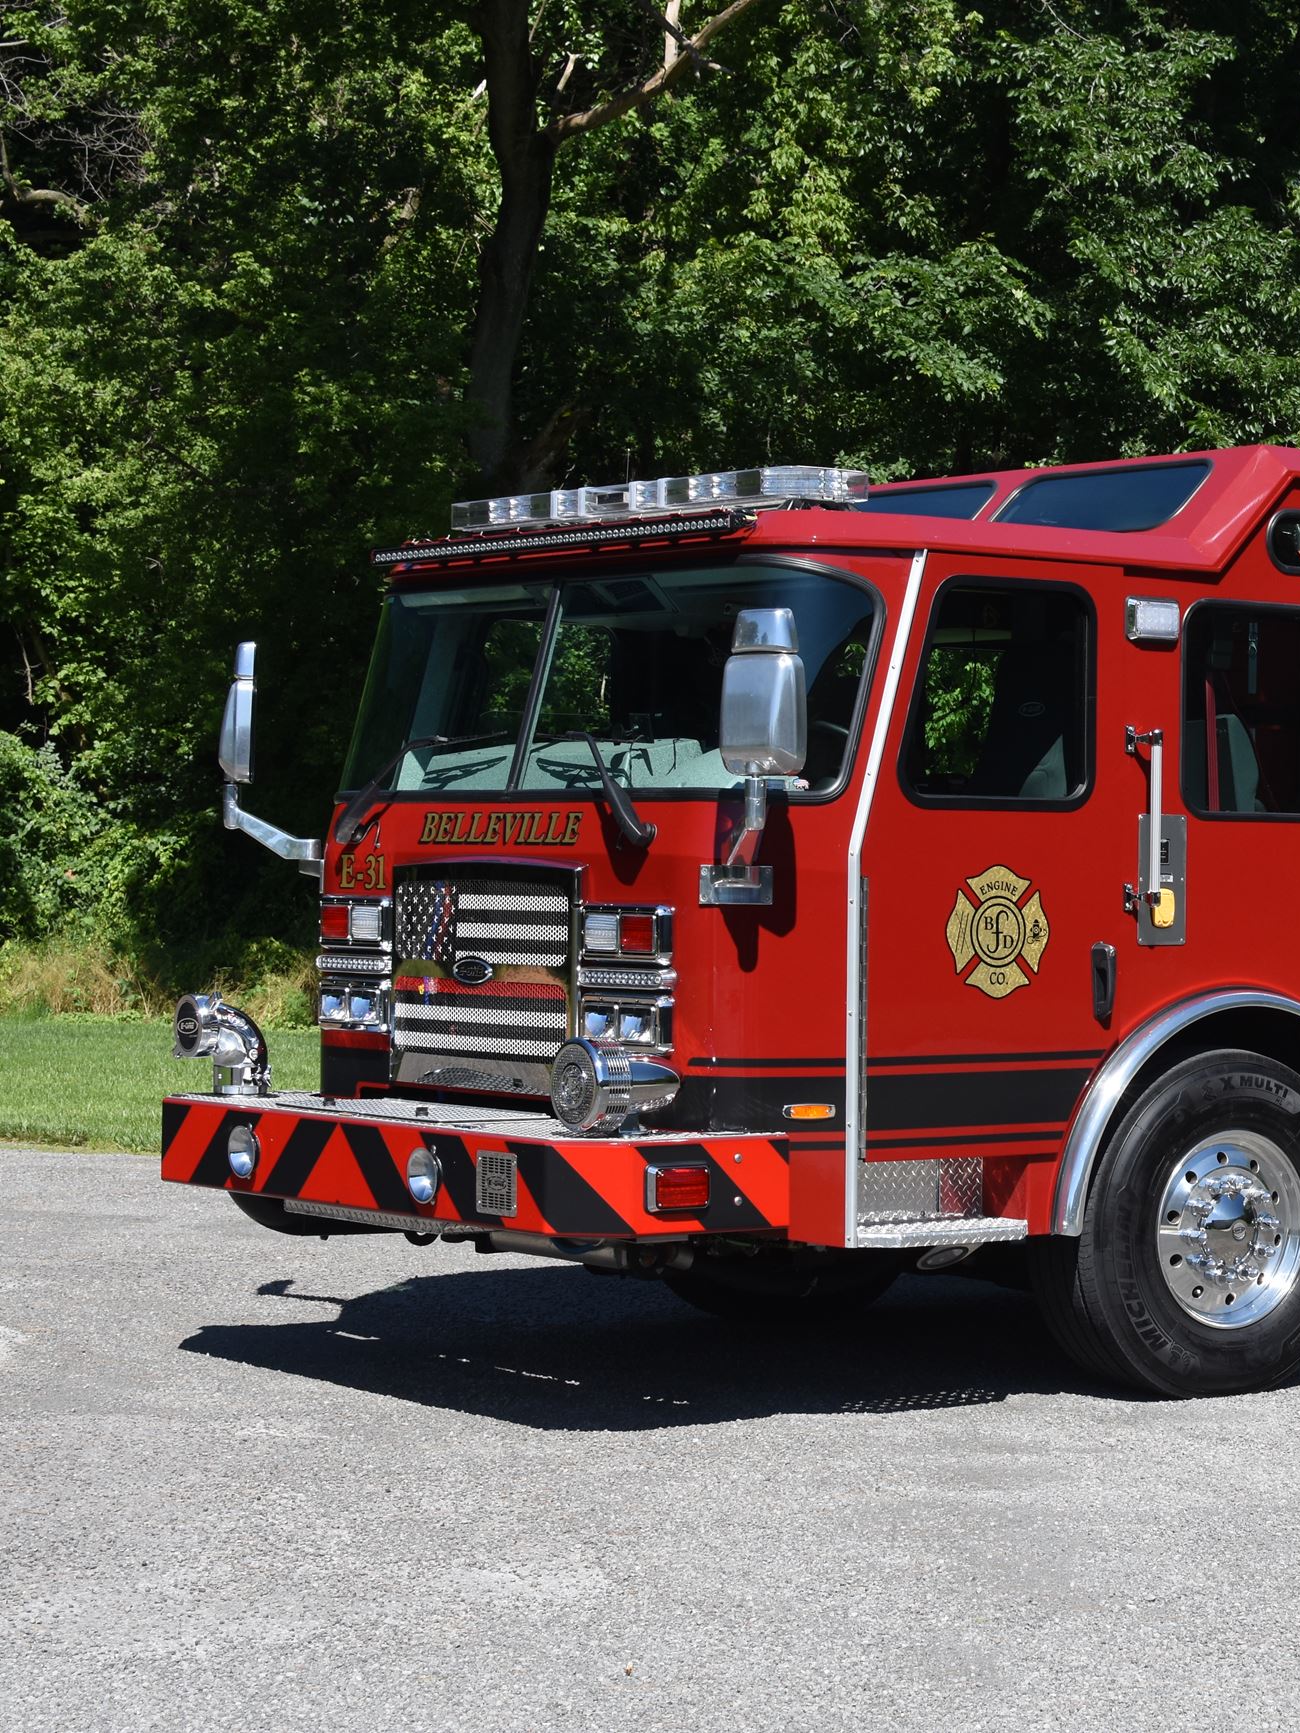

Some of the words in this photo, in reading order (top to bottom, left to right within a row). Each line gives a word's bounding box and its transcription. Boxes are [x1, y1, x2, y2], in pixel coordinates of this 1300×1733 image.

[419, 811, 584, 846] BELLEVILLE
[340, 854, 387, 889] E-31
[979, 880, 1018, 897] ENGINE
[989, 972, 1009, 985] CO.
[1239, 1075, 1289, 1099] MULTI
